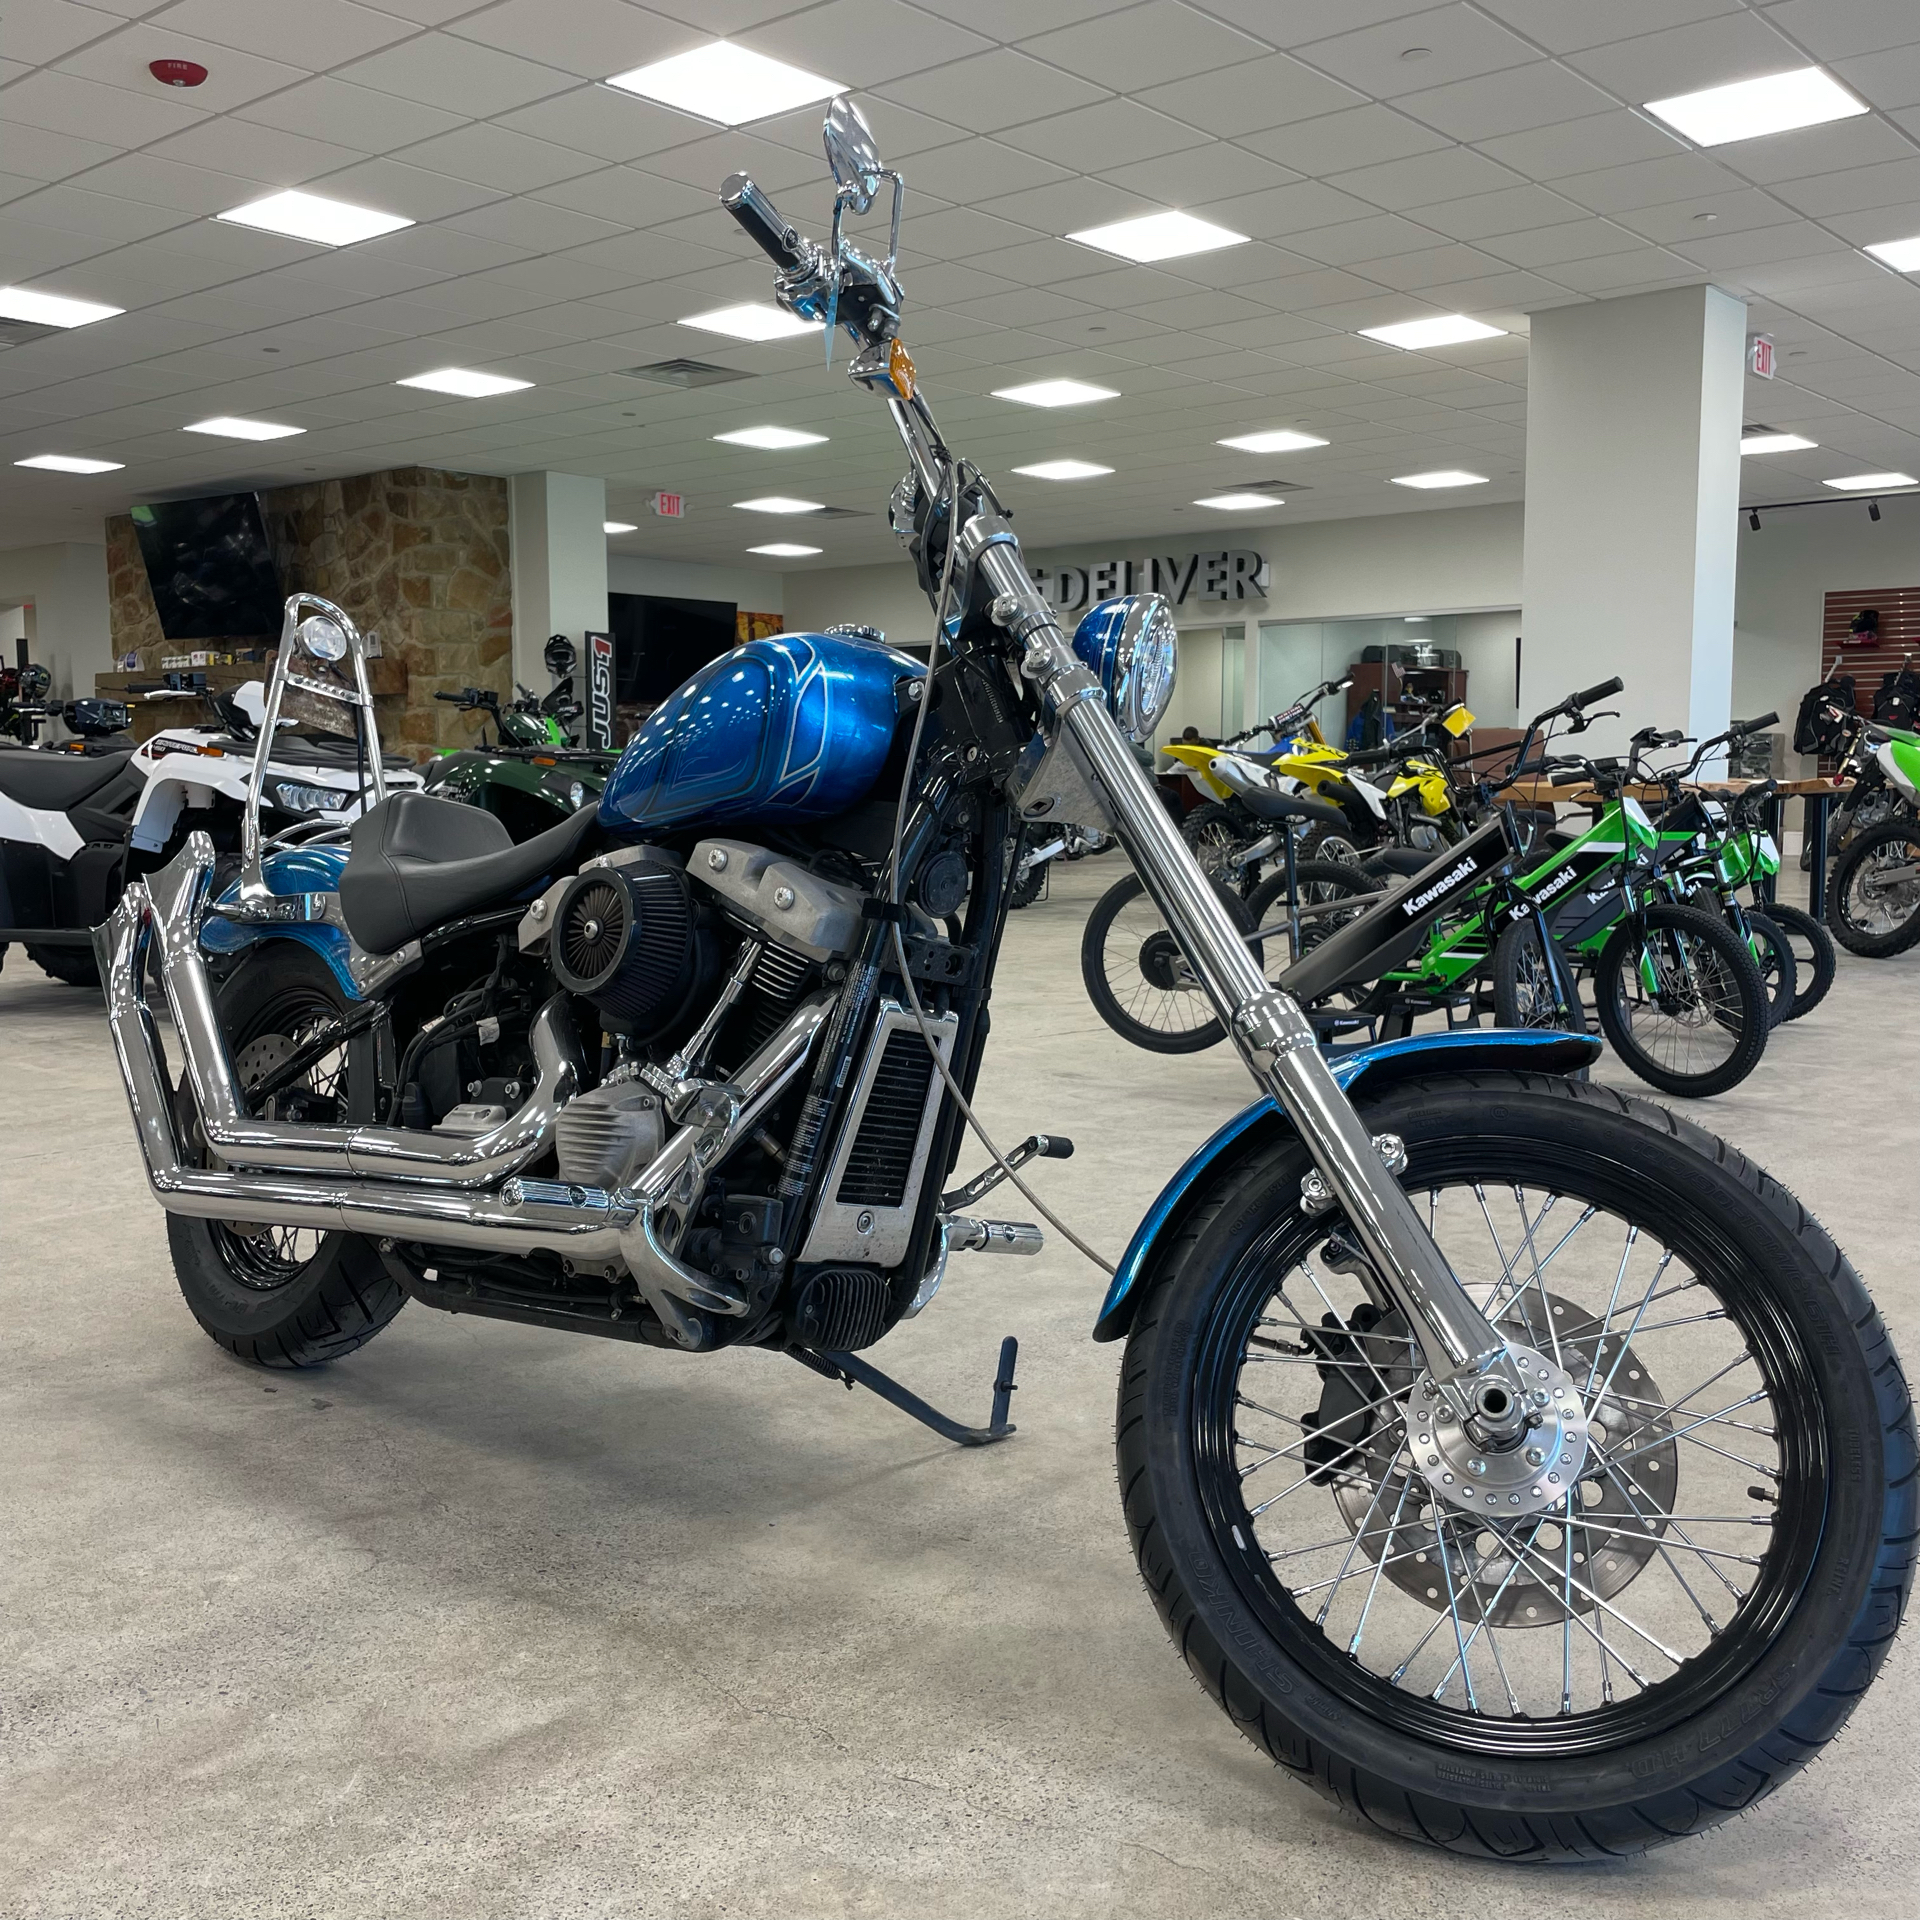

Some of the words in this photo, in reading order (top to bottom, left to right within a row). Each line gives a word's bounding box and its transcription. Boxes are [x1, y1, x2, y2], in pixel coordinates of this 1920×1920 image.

[167, 62, 188, 70] FIRE
[1756, 340, 1772, 375] EXIT
[660, 493, 681, 516] EXIT
[1402, 856, 1478, 916] Kawasaki
[1187, 1551, 1302, 1691] SHINKO
